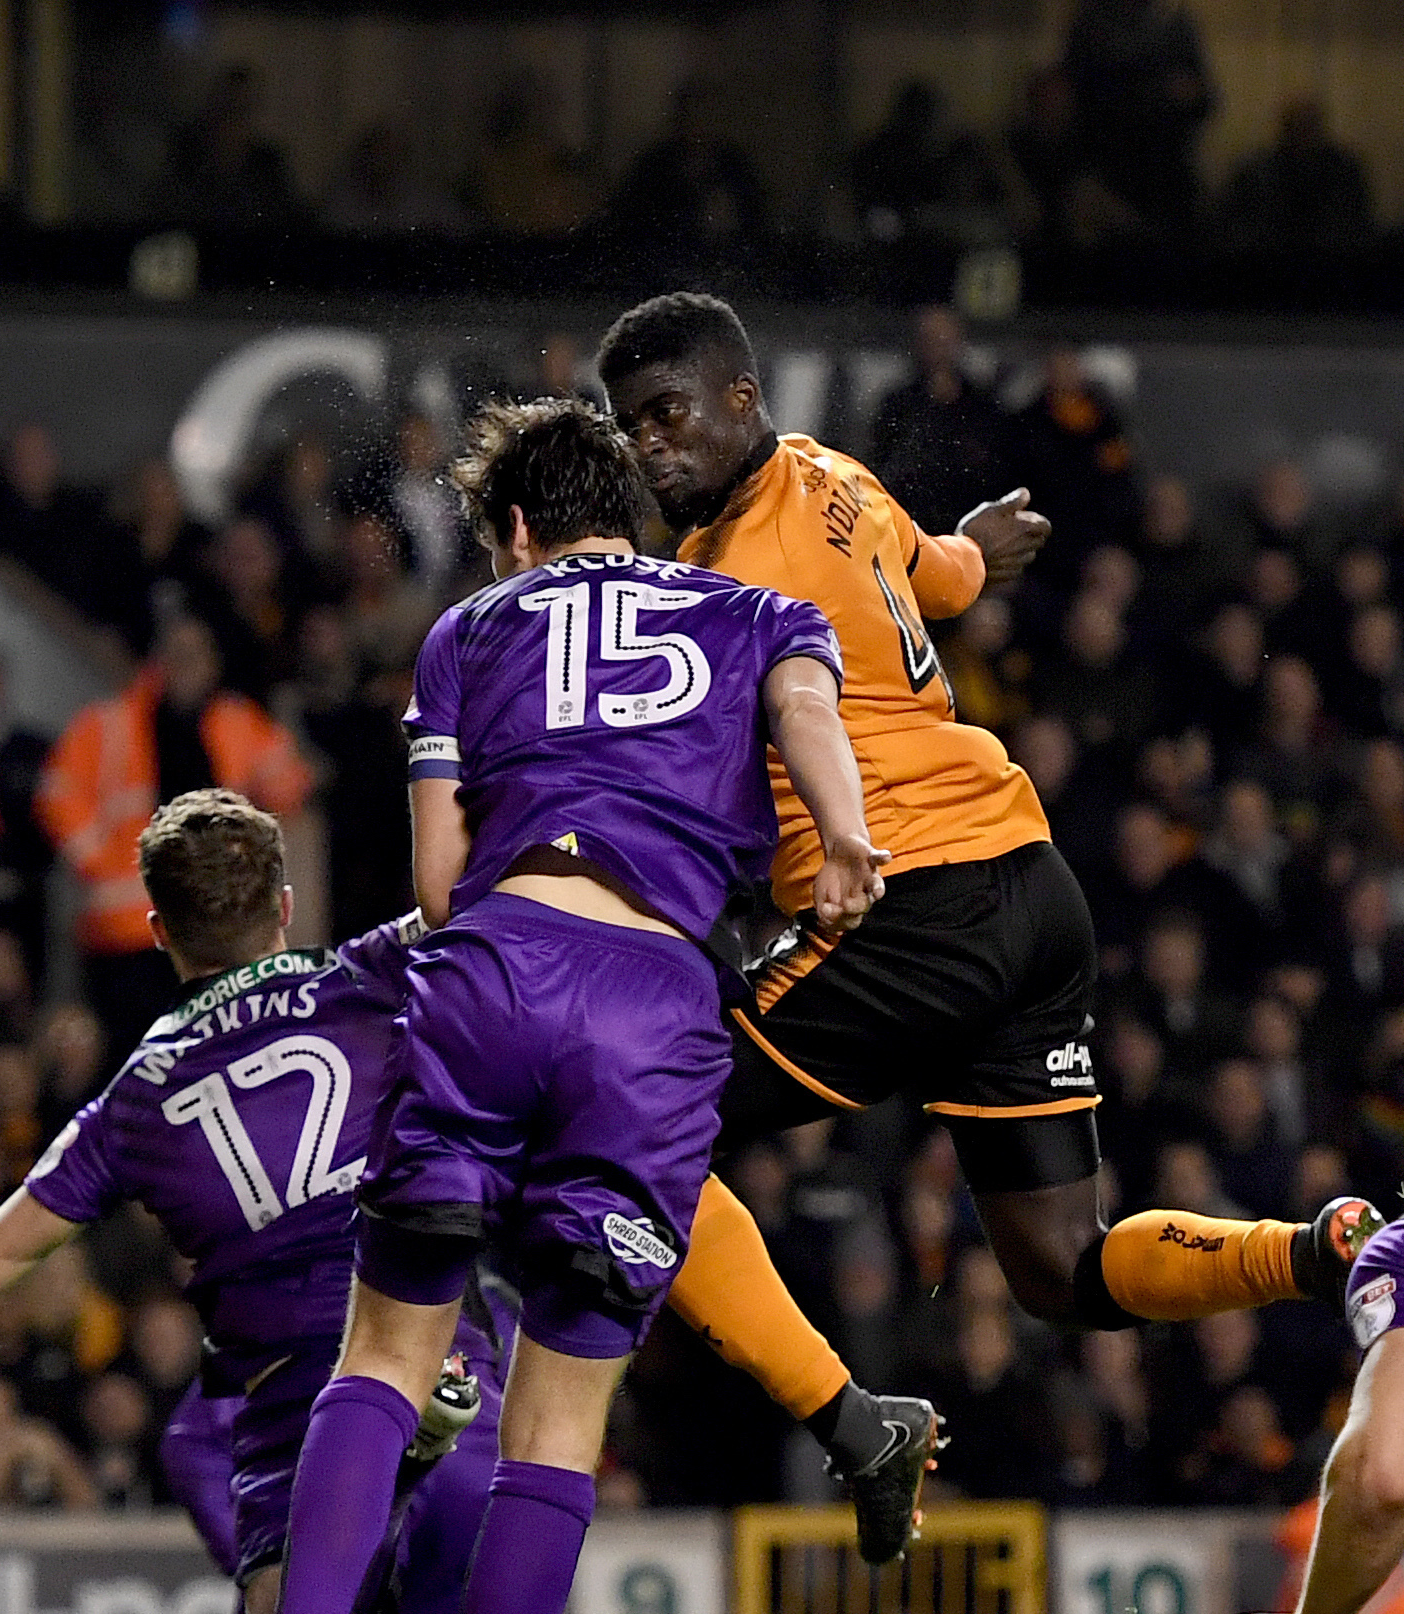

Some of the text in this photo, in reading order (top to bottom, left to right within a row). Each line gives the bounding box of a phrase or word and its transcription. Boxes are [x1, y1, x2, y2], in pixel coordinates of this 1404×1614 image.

[517, 581, 712, 731] 15
[871, 552, 956, 714] 4
[633, 713, 648, 721] EFL
[160, 1034, 368, 1233] 12
[606, 1216, 674, 1266] SHRED STATION
